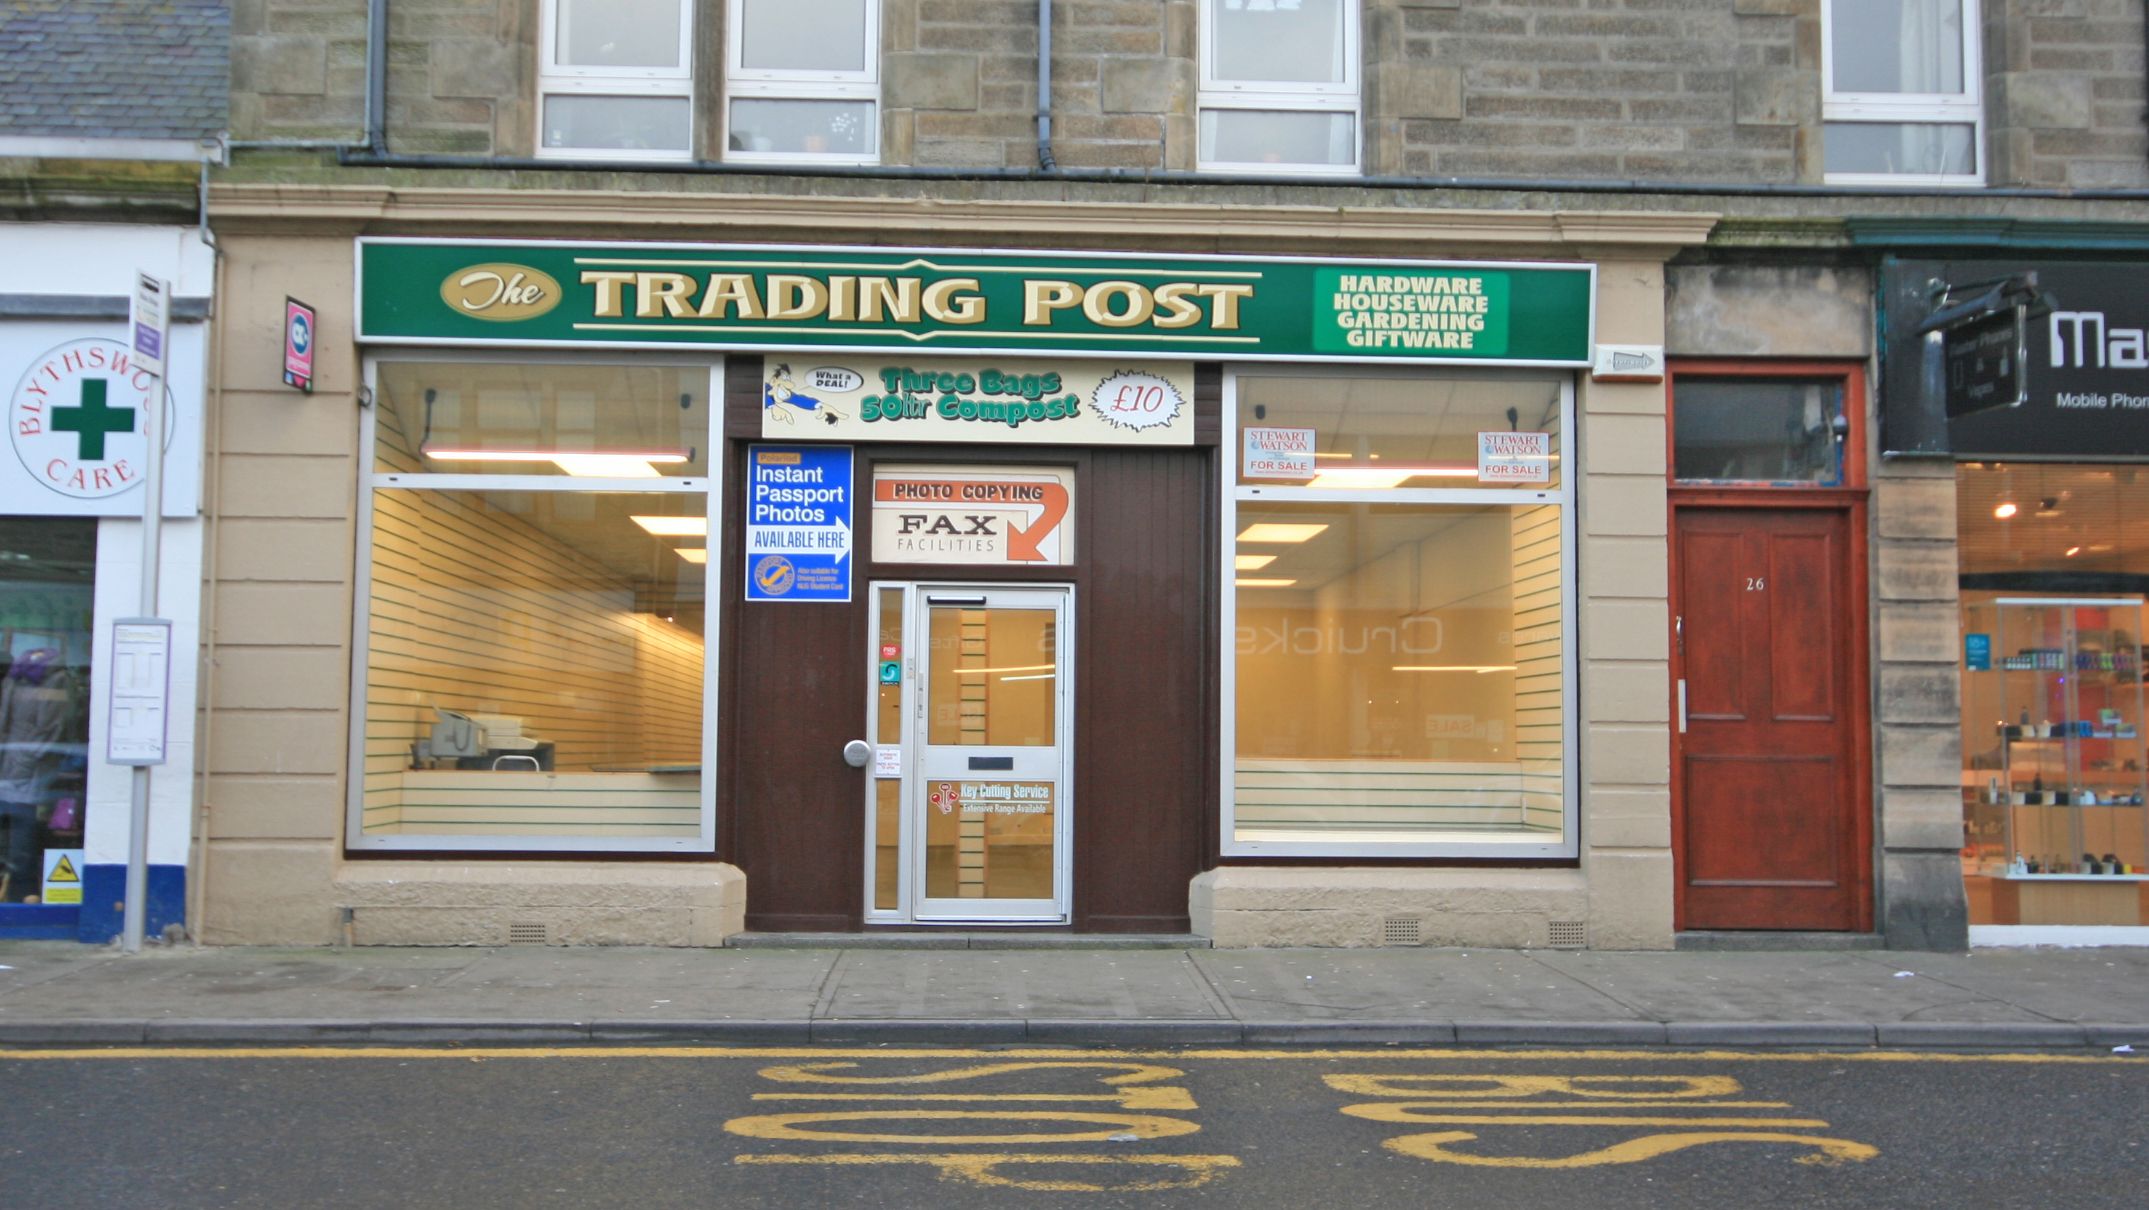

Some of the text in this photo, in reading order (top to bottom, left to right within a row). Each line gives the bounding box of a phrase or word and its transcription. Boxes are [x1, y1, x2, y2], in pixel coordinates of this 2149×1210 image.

[1339, 275, 1483, 296] HARDWARE
[460, 270, 1254, 330] The TRADING POST
[1333, 293, 1488, 314] HOUSEWARE
[1337, 311, 1485, 331] GARDENING
[1346, 329, 1474, 349] GIFTWARE
[2050, 311, 2149, 368] Ma
[816, 371, 843, 380] What
[816, 379, 848, 389] DEAL!
[879, 366, 1062, 400] Three Bags
[18, 347, 151, 437] BLYTHSWO
[1109, 385, 1166, 413] £10
[2056, 391, 2108, 408] Mobile
[935, 393, 1081, 429] Compost
[1251, 431, 1308, 441] STEWART
[1485, 434, 1540, 445] STEWART
[1260, 440, 1308, 451] WATSON
[1494, 444, 1541, 455] WATSON
[46, 458, 135, 490] CARE
[756, 465, 824, 483] Instant
[1250, 460, 1308, 471] FOR SALE
[1485, 464, 1542, 475] FOR SALE
[756, 484, 844, 507] Passport
[893, 483, 1044, 501] PHOTO COPYING
[755, 504, 825, 522] Photos
[898, 514, 998, 536] FAX
[754, 531, 845, 548] AVAILABLE HERE
[897, 538, 995, 552] FACILITIES
[1747, 577, 1764, 590] 26
[961, 783, 1050, 800] Key Cutting Service
[963, 803, 1047, 815] Extensive Range Available
